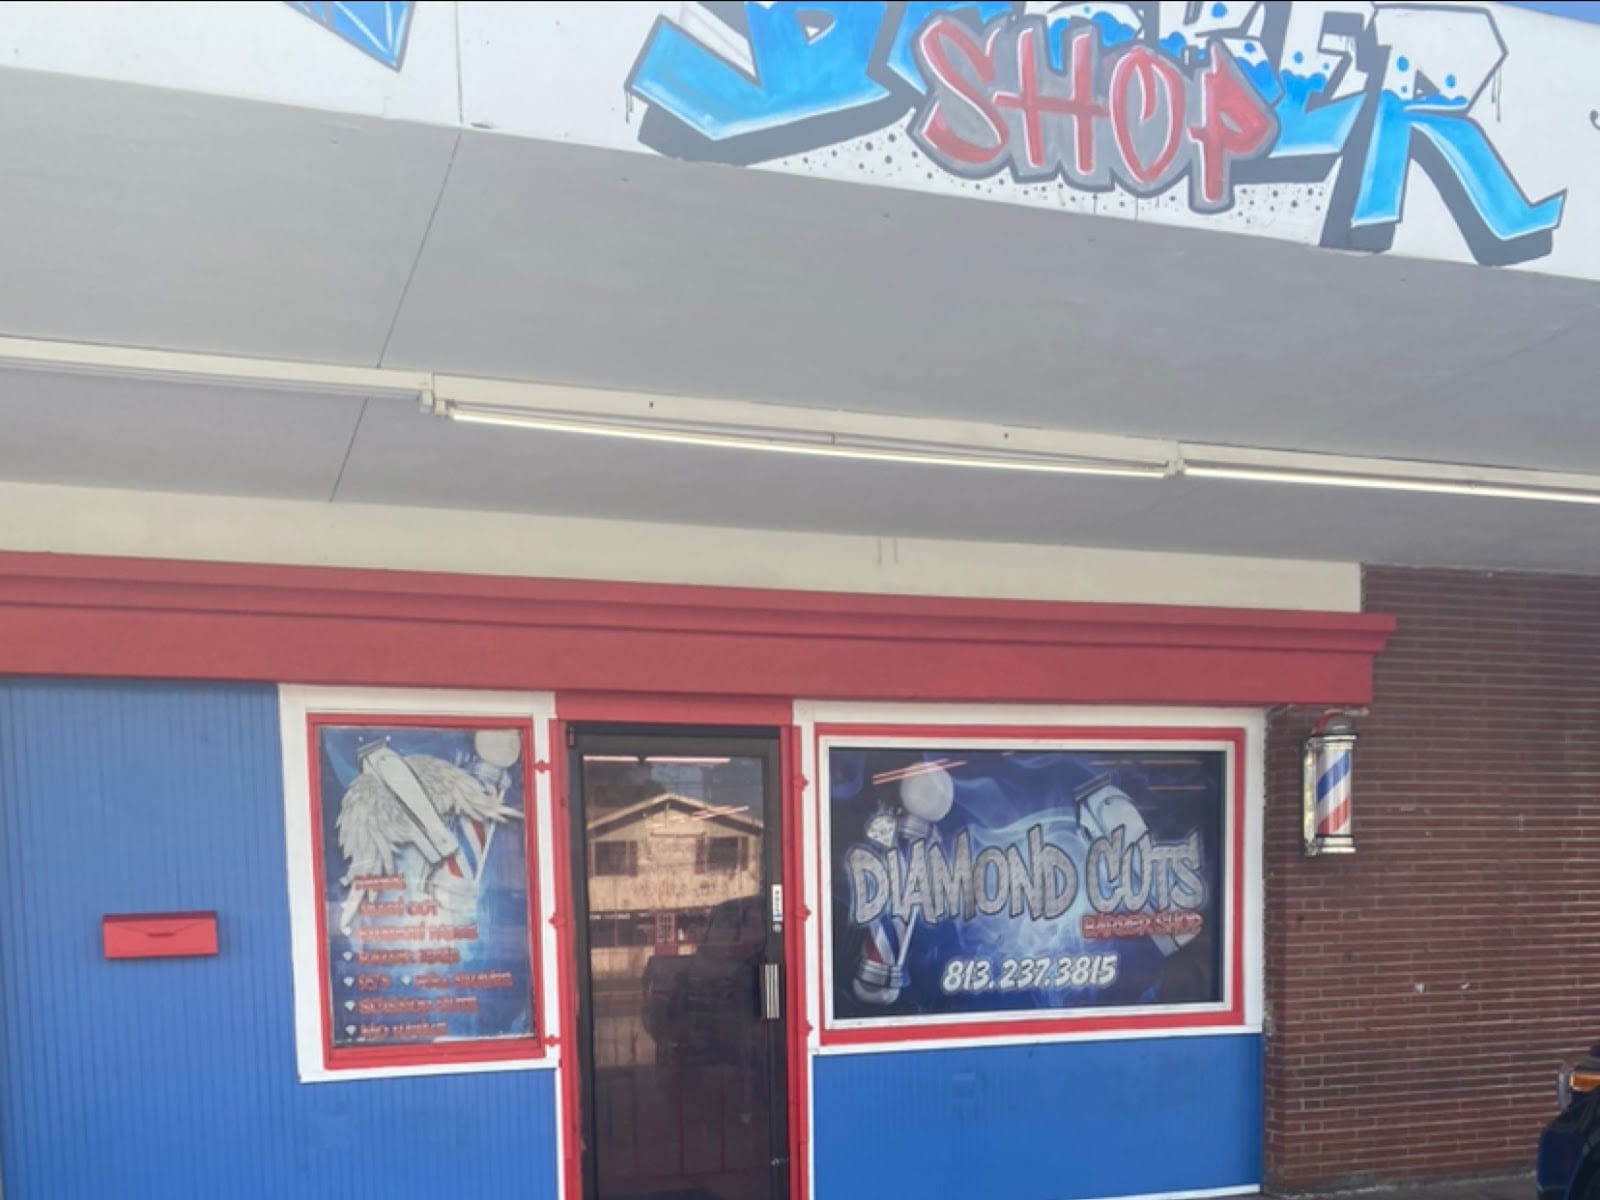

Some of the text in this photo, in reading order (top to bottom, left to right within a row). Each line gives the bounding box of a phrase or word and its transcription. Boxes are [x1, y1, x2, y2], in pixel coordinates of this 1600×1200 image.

[913, 14, 1276, 210] SHOP
[848, 823, 1208, 925] DIAMOND CUTS
[941, 955, 1119, 993] 813.237.3815
